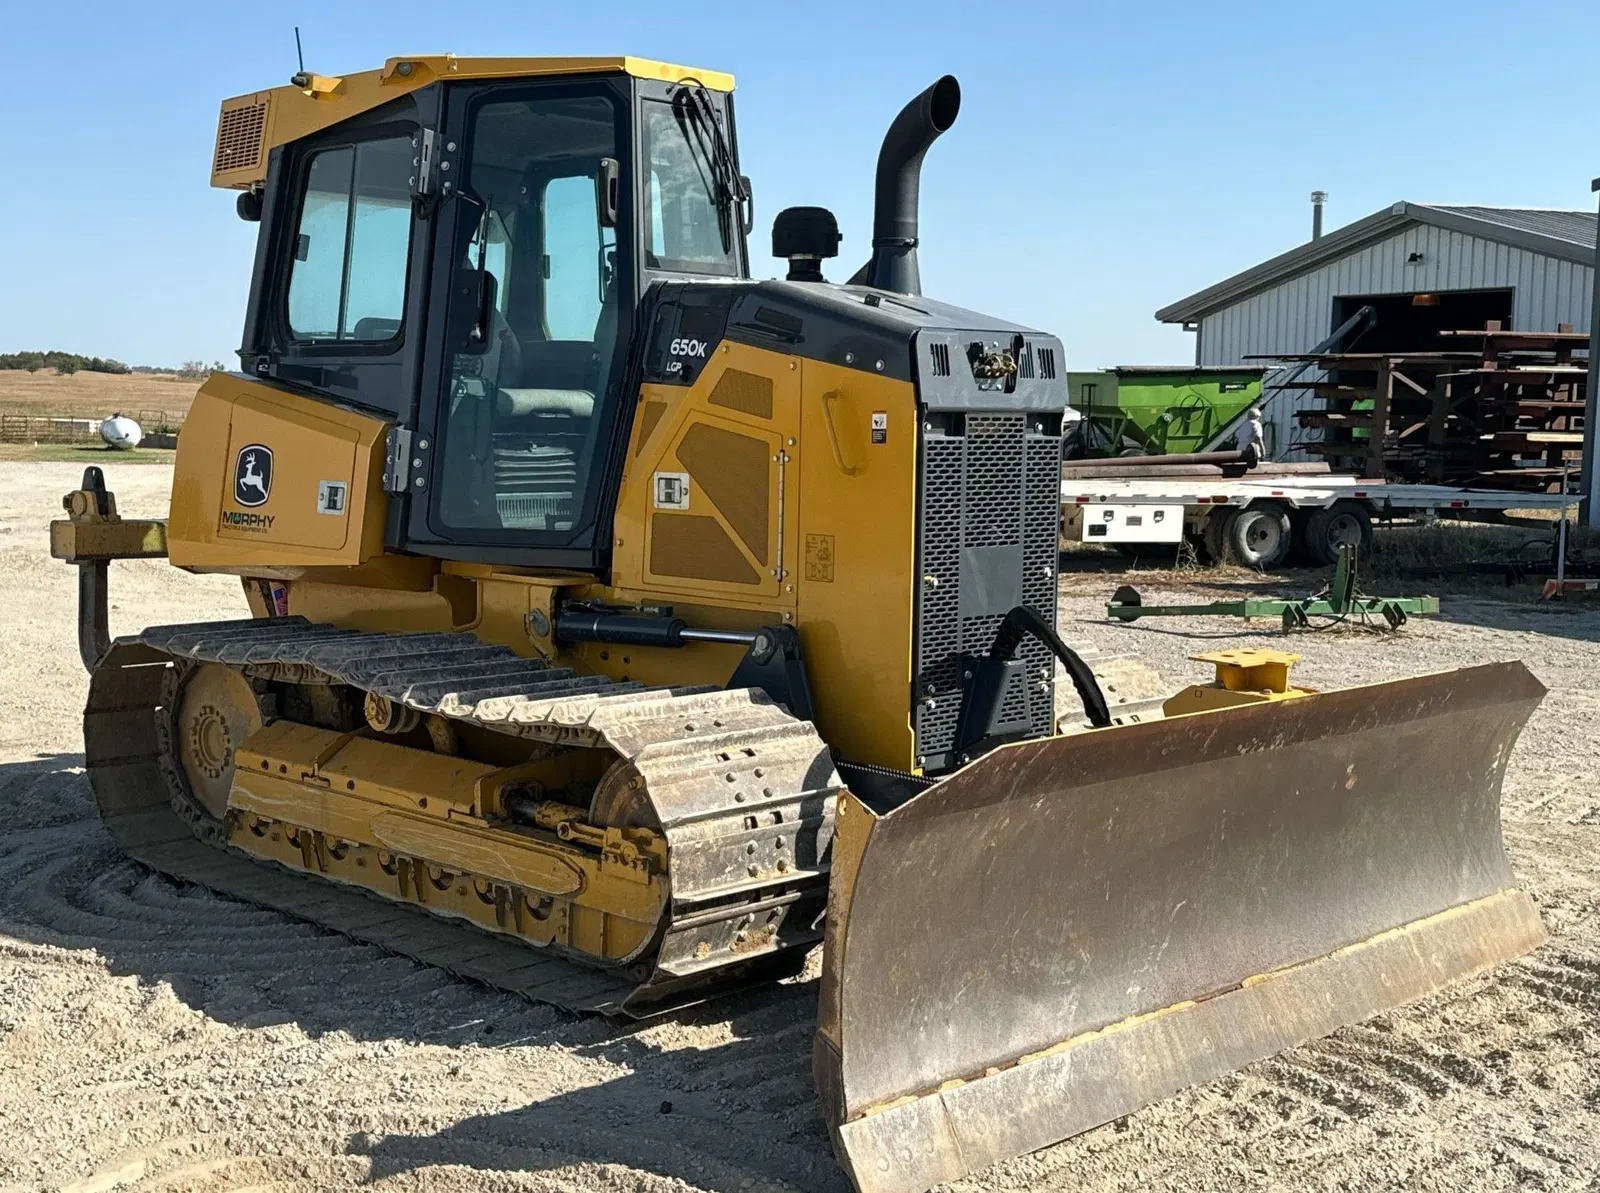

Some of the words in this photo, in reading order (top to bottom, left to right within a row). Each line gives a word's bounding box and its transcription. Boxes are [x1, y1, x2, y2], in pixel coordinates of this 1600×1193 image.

[670, 338, 707, 358] 650K
[666, 362, 682, 372] LGP
[222, 511, 275, 528] MURPHY
